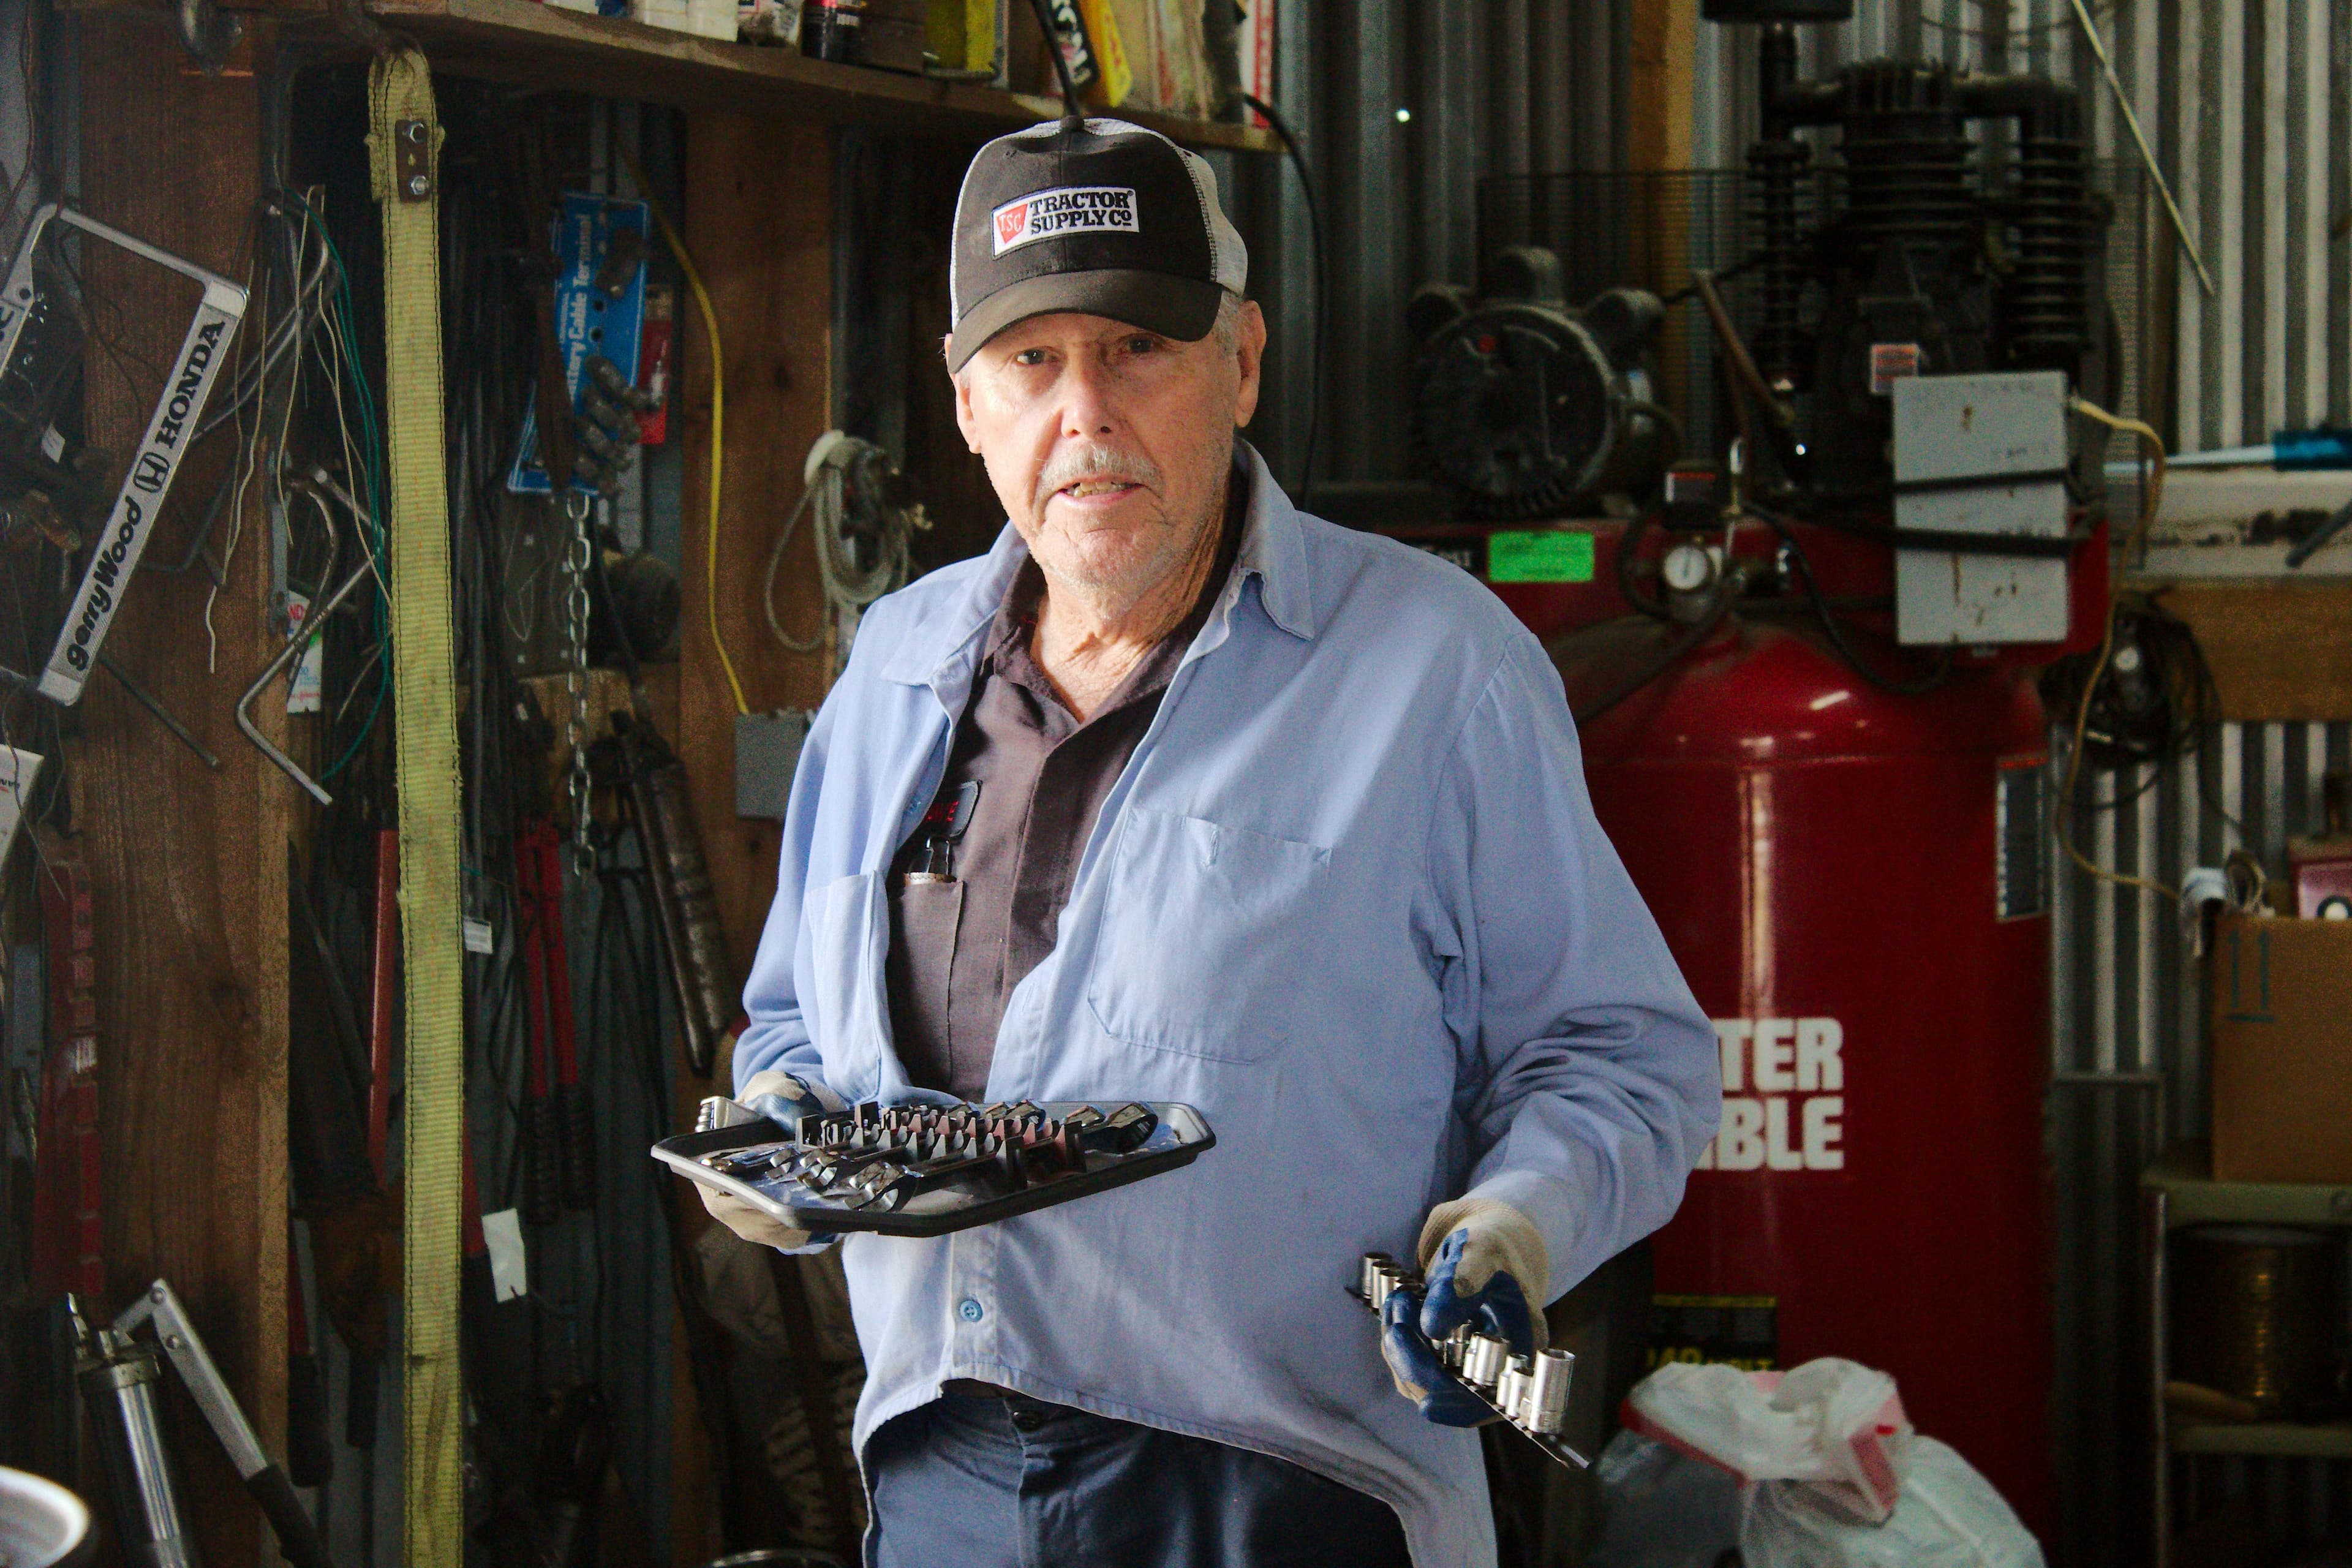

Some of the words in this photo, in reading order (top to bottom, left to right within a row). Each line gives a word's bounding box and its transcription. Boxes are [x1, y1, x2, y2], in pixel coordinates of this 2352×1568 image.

[999, 213, 1022, 233] TSC
[1030, 192, 1130, 216] TRACTOR
[1031, 210, 1106, 235] SUPPLY
[573, 214, 592, 287] Terminal
[568, 292, 587, 339] Cable
[155, 320, 226, 450] HONDA
[1710, 1017, 1844, 1091] TER
[1695, 1095, 1844, 1170] BLE
